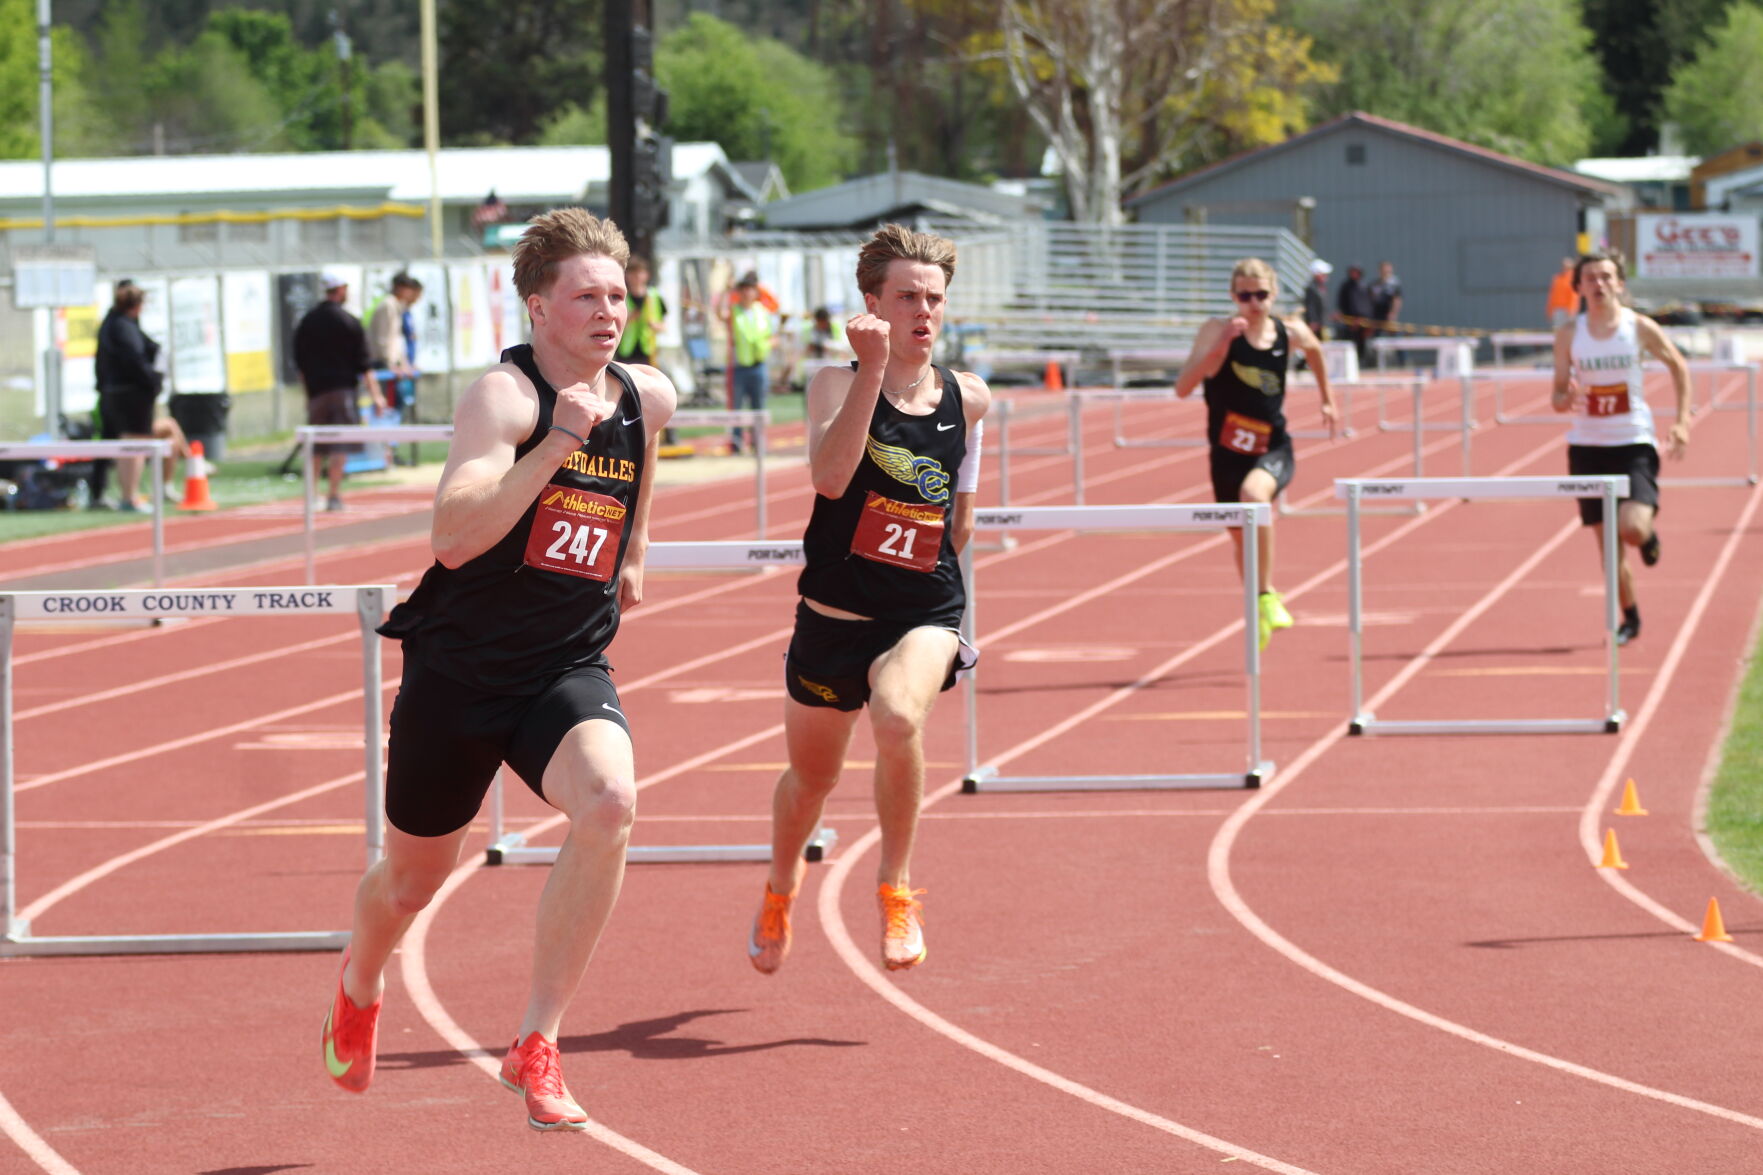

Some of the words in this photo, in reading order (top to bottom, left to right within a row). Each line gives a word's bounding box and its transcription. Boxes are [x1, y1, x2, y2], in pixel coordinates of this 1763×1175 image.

[1597, 395, 1618, 415] 77
[1231, 428, 1257, 452] 23
[545, 520, 608, 567] 247
[878, 523, 918, 560] 21
[43, 597, 127, 613] CROOK
[142, 594, 237, 611] COUNTY
[254, 592, 333, 609] TRACK
